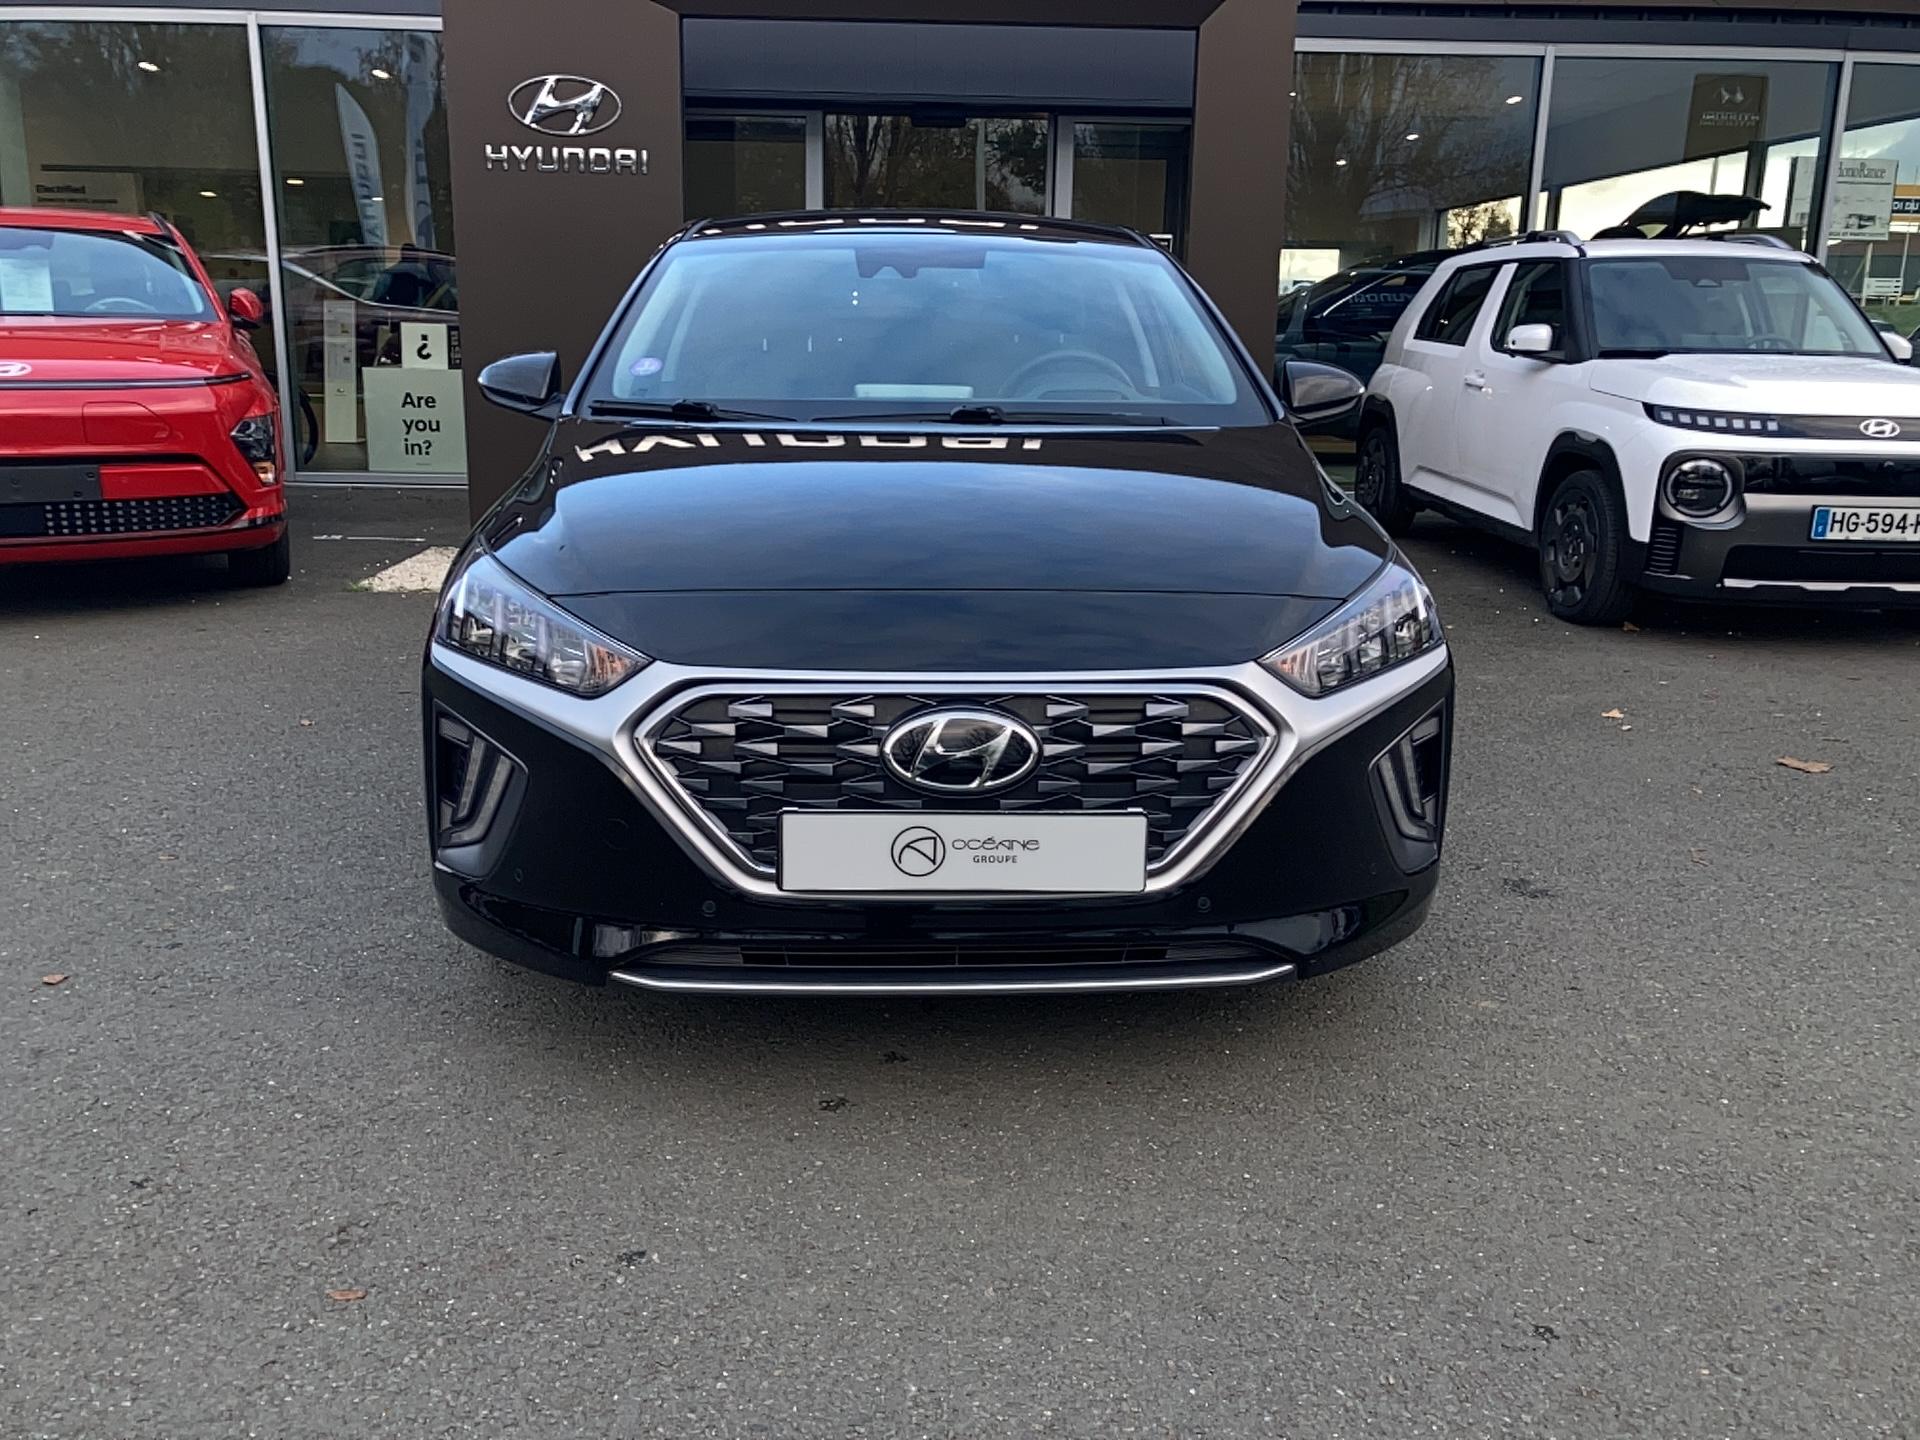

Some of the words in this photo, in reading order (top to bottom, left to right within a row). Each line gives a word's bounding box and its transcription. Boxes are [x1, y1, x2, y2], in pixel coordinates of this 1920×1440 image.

[485, 144, 648, 175] HYUNDAI
[401, 392, 437, 408] Are
[402, 419, 440, 435] you
[405, 438, 432, 455] in?
[973, 855, 1018, 864] GROUPE
